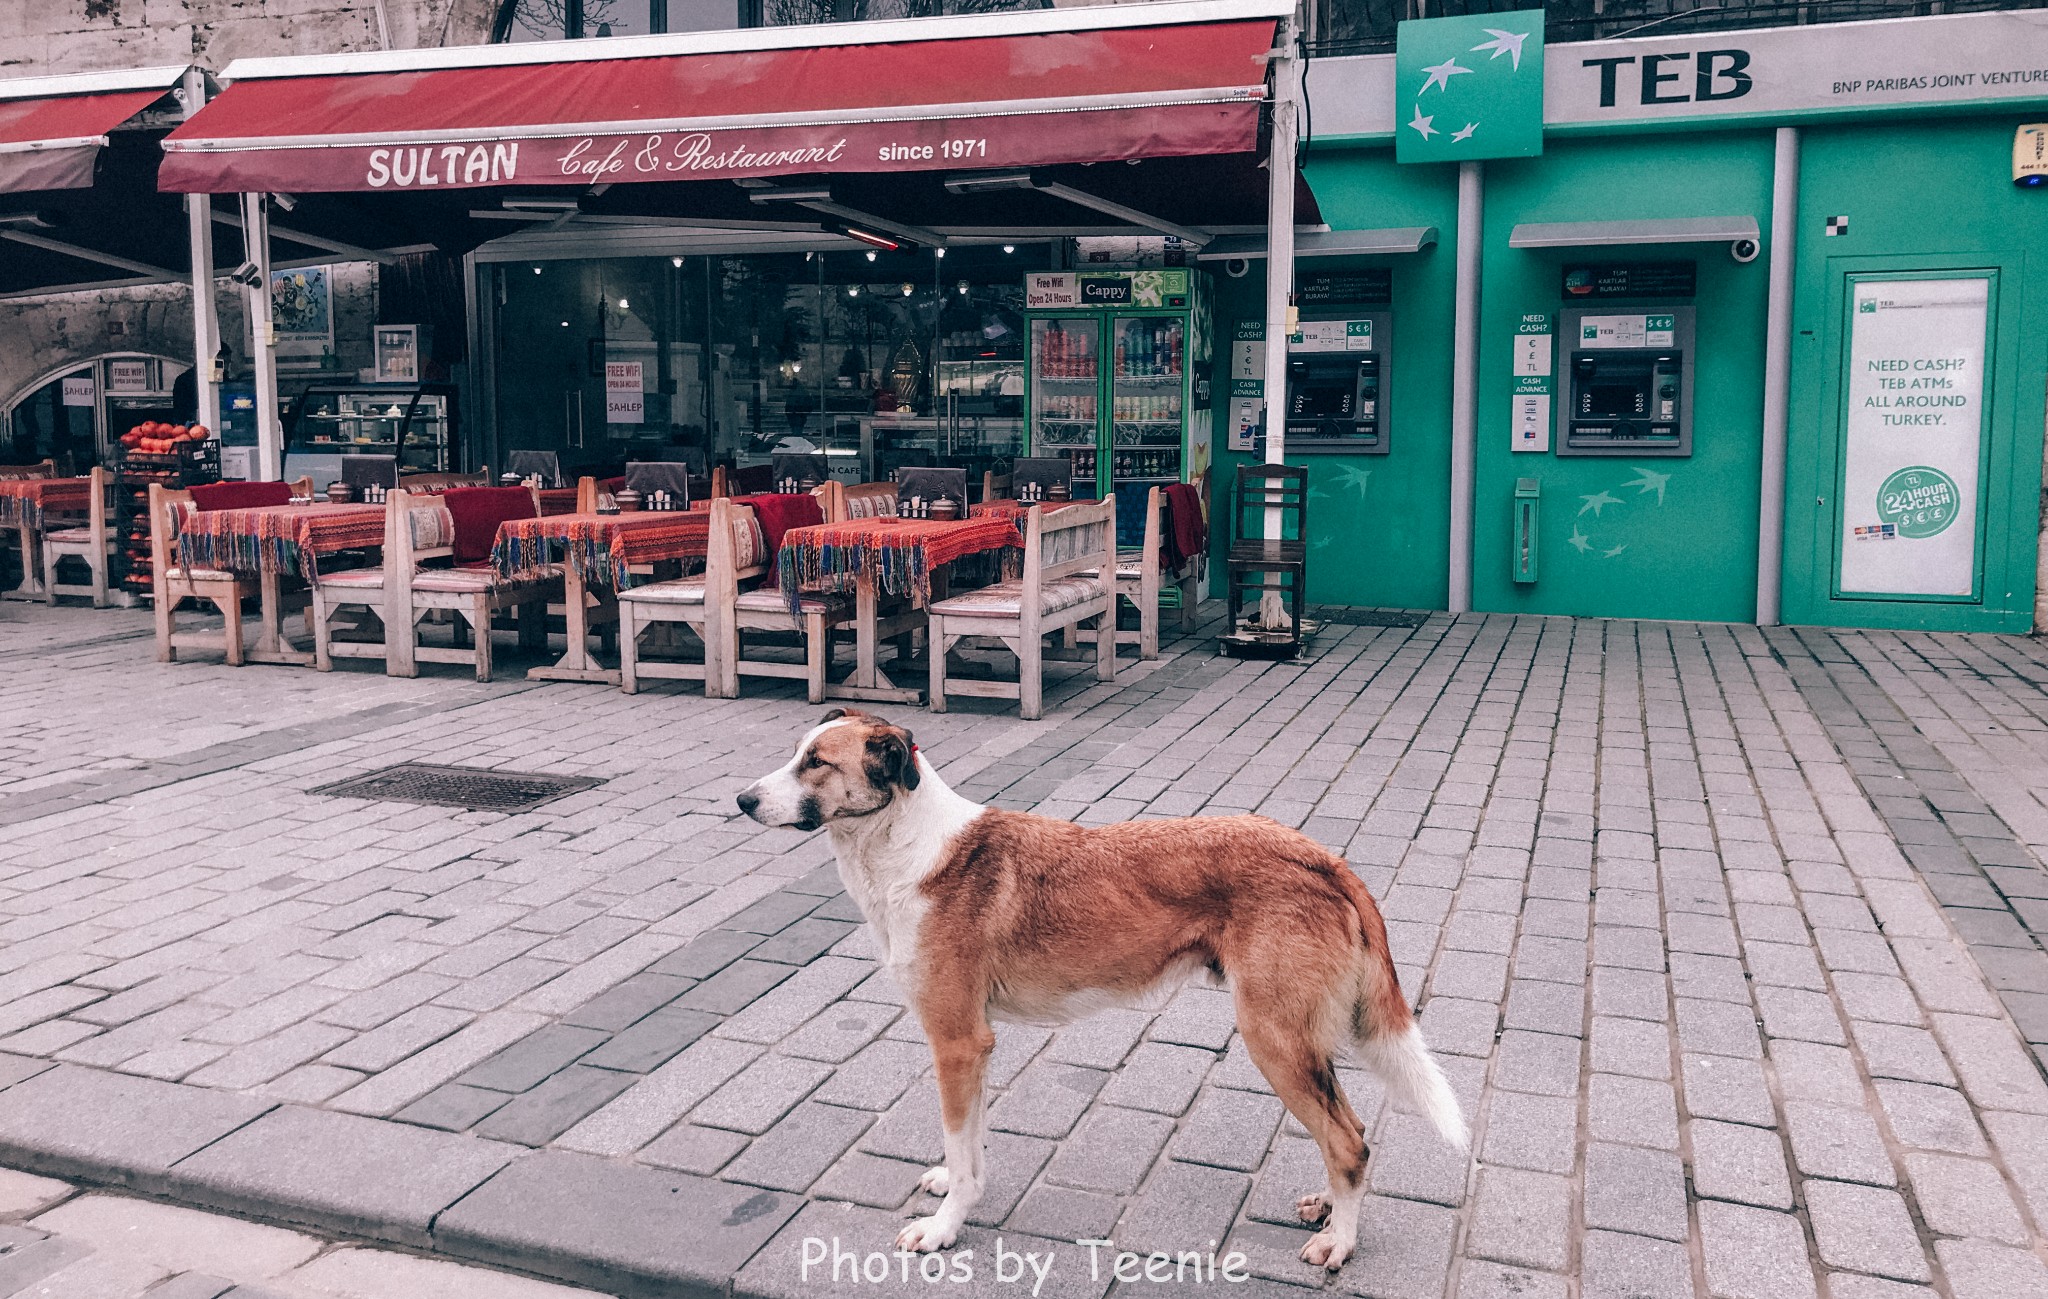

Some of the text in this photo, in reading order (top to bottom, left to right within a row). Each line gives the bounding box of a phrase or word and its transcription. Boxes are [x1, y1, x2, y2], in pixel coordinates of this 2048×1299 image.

[1583, 49, 1752, 107] TEB
[1833, 69, 2048, 94] BNP PARIBAS JOINT VENTURE
[879, 139, 986, 160] since 1971
[557, 132, 846, 185] Cafe & Restaurant
[367, 143, 518, 187] SULTAN
[1037, 278, 1050, 288] Free
[1086, 284, 1126, 299] Cappy
[1029, 293, 1072, 306] Open 24 Hours
[1348, 325, 1354, 333] $
[1356, 324, 1361, 332] €
[1520, 324, 1547, 332] CASH?
[1648, 319, 1654, 328] $
[1656, 319, 1663, 327] €
[1238, 331, 1263, 339] CASH?
[1246, 345, 1251, 353] $
[1868, 359, 1965, 371] NEED CASH?
[114, 368, 129, 376] FREE
[607, 366, 625, 377] FREE
[1879, 377, 1953, 389] TEB ATMs
[64, 387, 94, 395] SAHLEP
[608, 403, 642, 411] SAHLEP
[1865, 395, 1966, 407] ALL AROUND
[1882, 414, 1947, 426] TURKEY.
[1907, 476, 1919, 485] TL
[1884, 483, 1948, 515] 24 HOUR
[1916, 493, 1950, 509] CASH
[1902, 509, 1942, 526] $ € £
